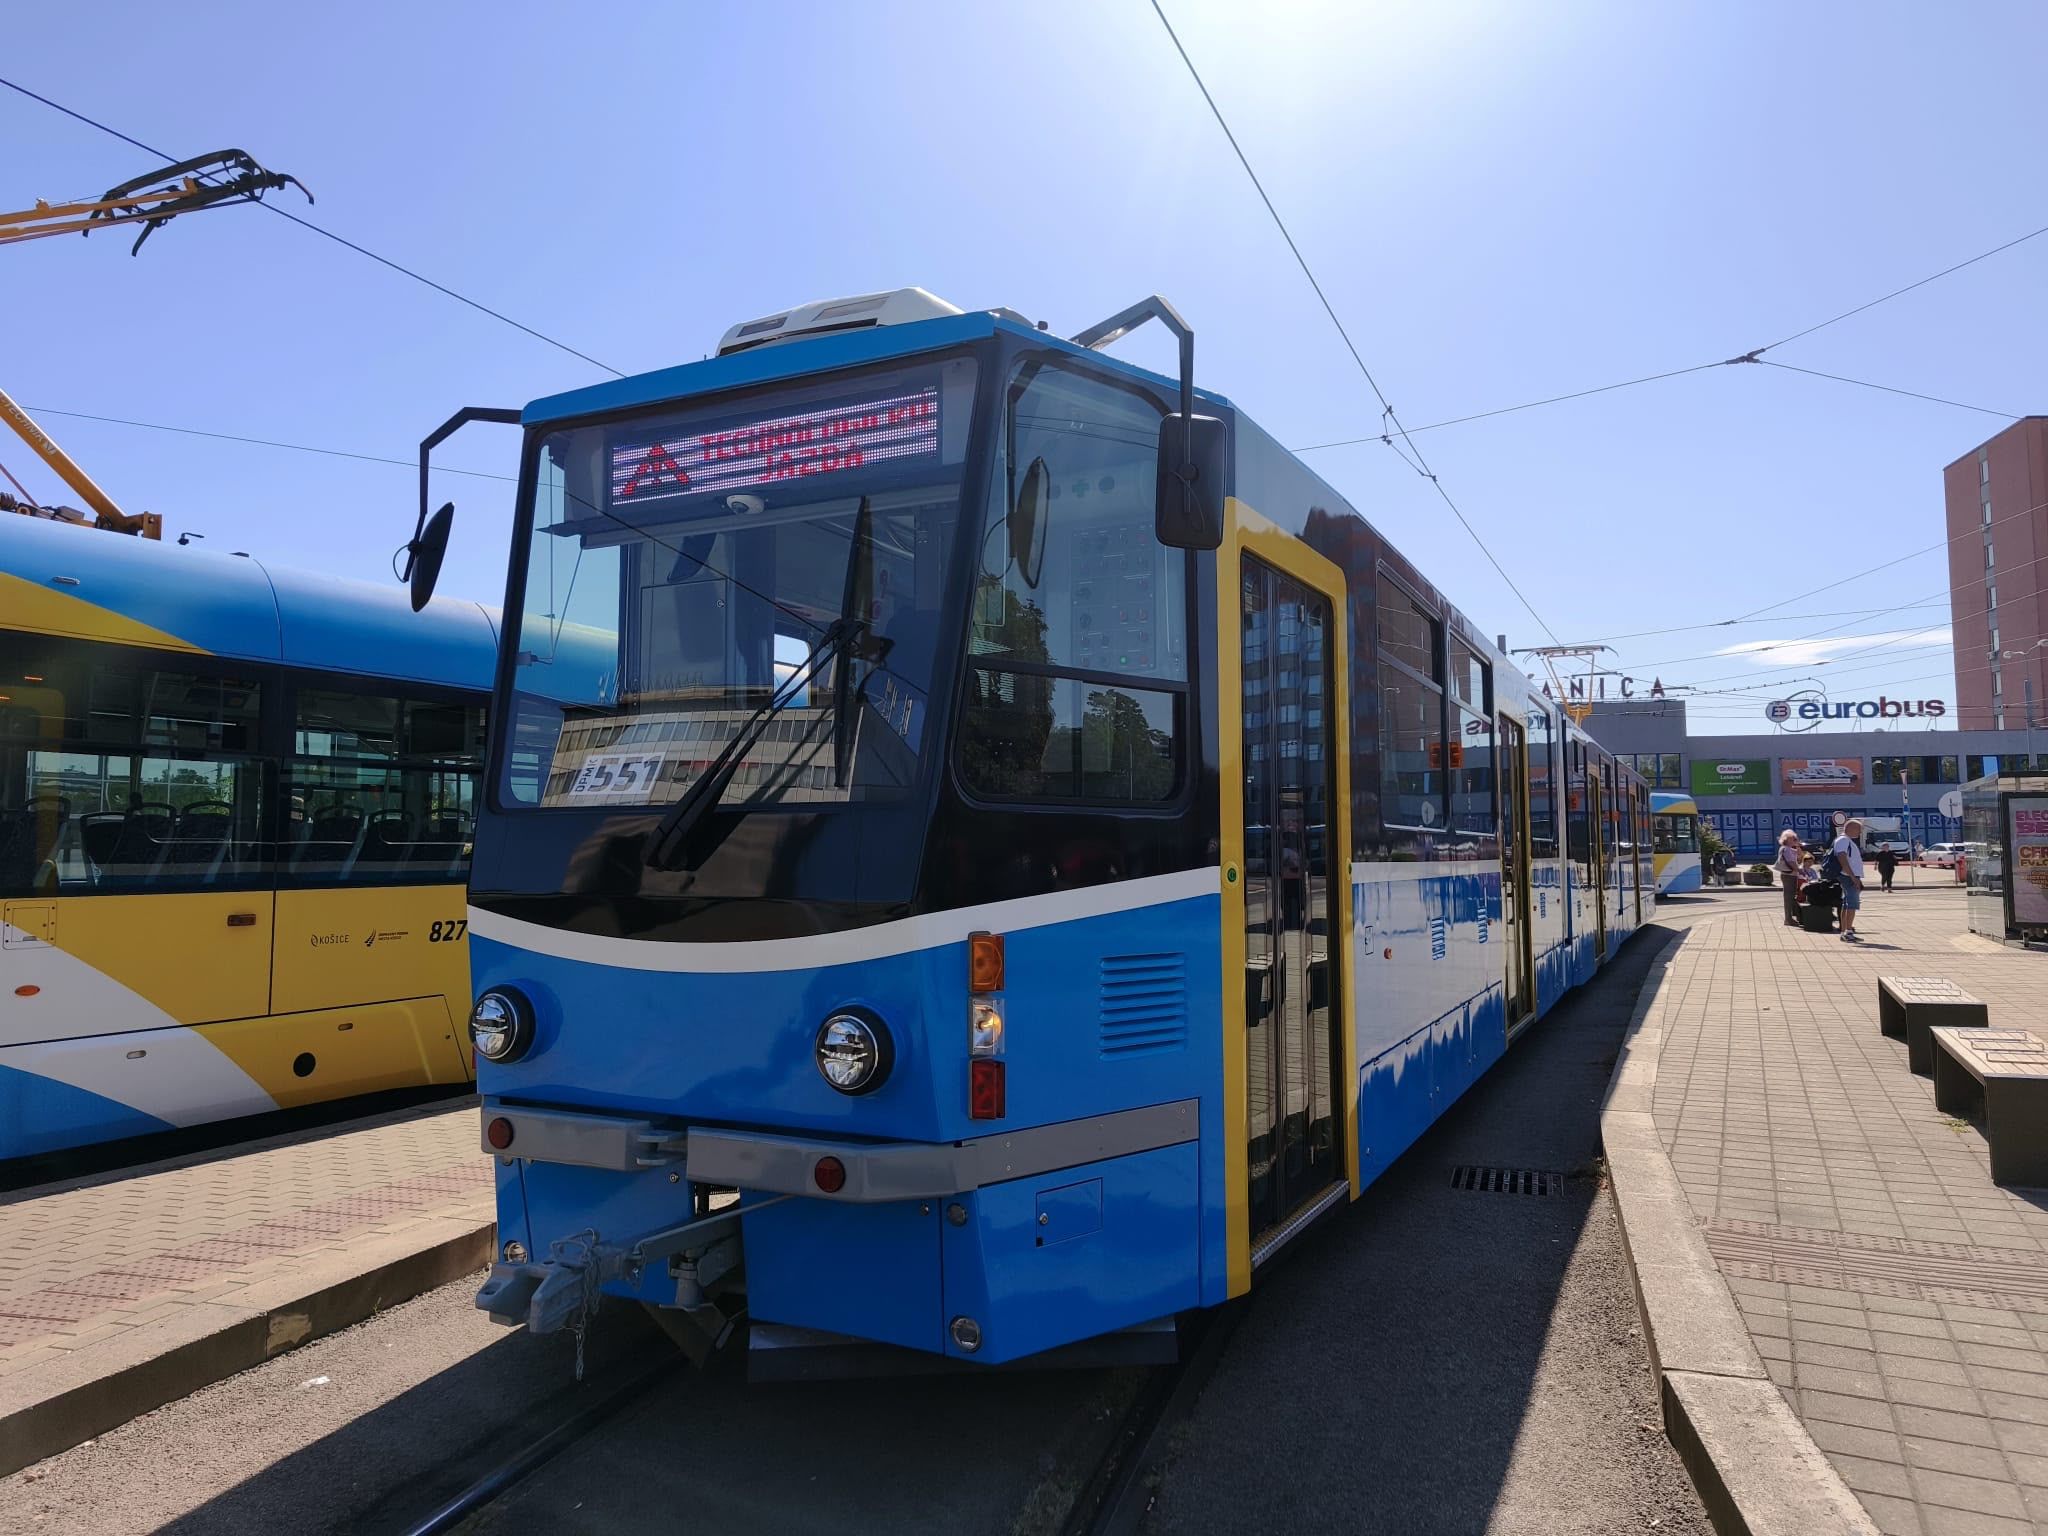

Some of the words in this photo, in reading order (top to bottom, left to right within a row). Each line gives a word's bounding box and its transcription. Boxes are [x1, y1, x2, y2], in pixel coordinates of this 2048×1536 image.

[1799, 696, 1946, 720] eurobus
[588, 756, 662, 792] 551
[319, 933, 350, 945] KOŠICE
[429, 919, 468, 943] 827
